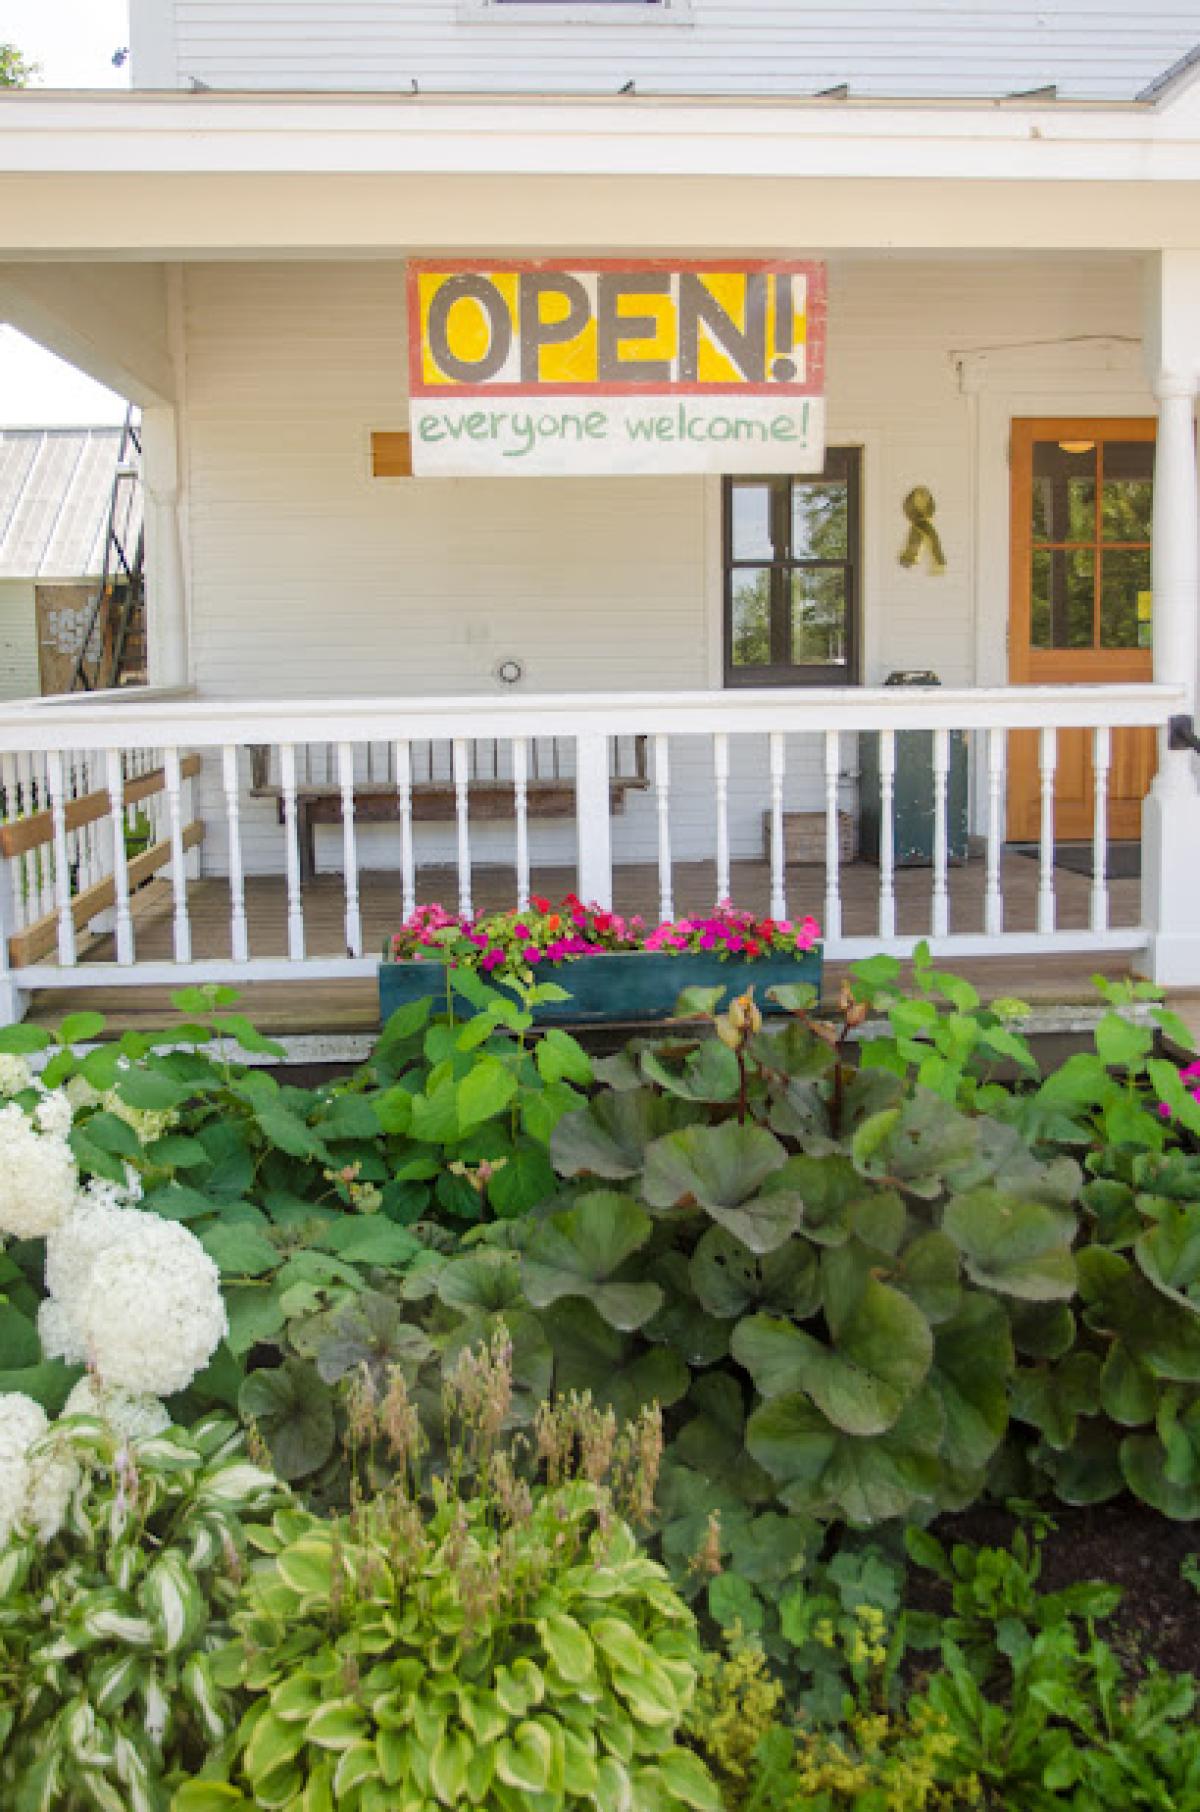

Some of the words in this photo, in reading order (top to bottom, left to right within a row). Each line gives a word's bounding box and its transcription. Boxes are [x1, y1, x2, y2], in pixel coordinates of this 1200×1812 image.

[427, 272, 798, 384] OPEN!
[418, 410, 609, 457] everyone
[624, 402, 810, 449] welcome!
